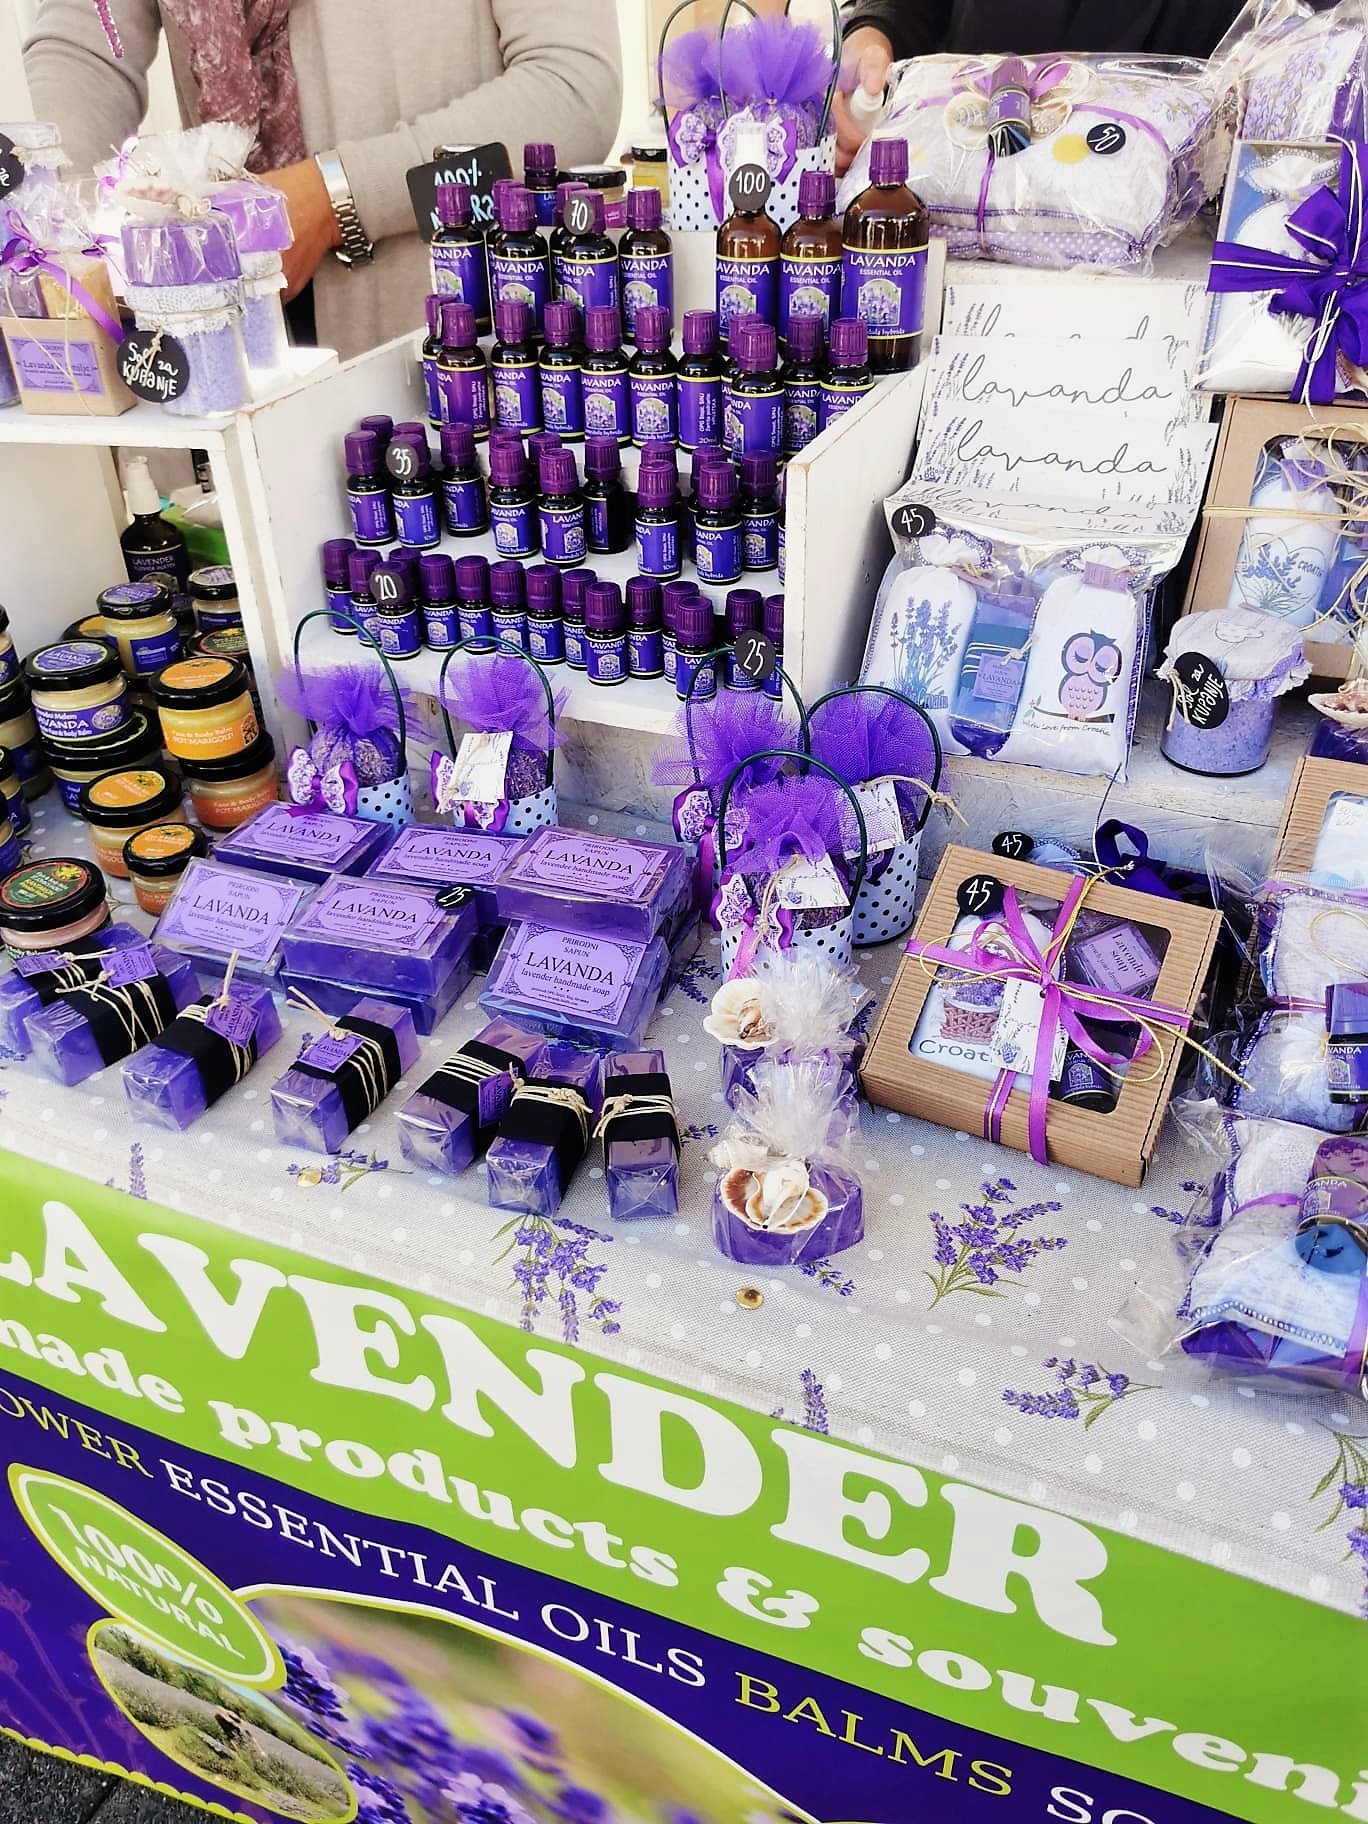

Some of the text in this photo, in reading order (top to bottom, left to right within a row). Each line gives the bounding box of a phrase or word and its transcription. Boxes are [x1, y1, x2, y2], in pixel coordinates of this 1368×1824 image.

[1088, 126, 1120, 152] 50
[736, 170, 766, 194] 100
[571, 199, 588, 231] 70
[850, 255, 916, 268] LAVANDA
[860, 269, 892, 277] ESSENTIAL
[790, 276, 820, 285] ESSENTIAL
[962, 354, 1173, 408] lavanda
[957, 419, 1168, 474] lavanda
[393, 447, 412, 475] 35
[900, 508, 925, 534] 45
[375, 575, 397, 600] 20
[744, 638, 766, 676] 25
[267, 822, 341, 843] LAVANDA
[1001, 833, 1023, 857] 45
[408, 845, 492, 861] LAVANDA
[540, 859, 572, 871] lavender
[544, 850, 633, 875] LAVANDA
[438, 886, 472, 907] 25
[965, 878, 994, 912] 45
[192, 895, 270, 925] LAVANDA
[332, 900, 418, 924] LAVANDA
[562, 936, 599, 951] PRIRODNI
[564, 946, 590, 958] SAPUN
[1112, 933, 1148, 978] Lavender
[525, 951, 614, 986] LAVANDA
[1112, 950, 1129, 972] soap
[521, 967, 553, 983] lavender
[553, 976, 592, 992] handmade
[592, 986, 611, 998] soap
[919, 1038, 994, 1065] Croat
[208, 1399, 679, 1588] products
[716, 1566, 820, 1629] &
[47, 1503, 223, 1625] 100%
[75, 1546, 246, 1660] NATURAL
[159, 1458, 519, 1622] ESSENTIAL
[541, 1603, 706, 1686] OILS
[733, 1671, 1012, 1797] BALMS
